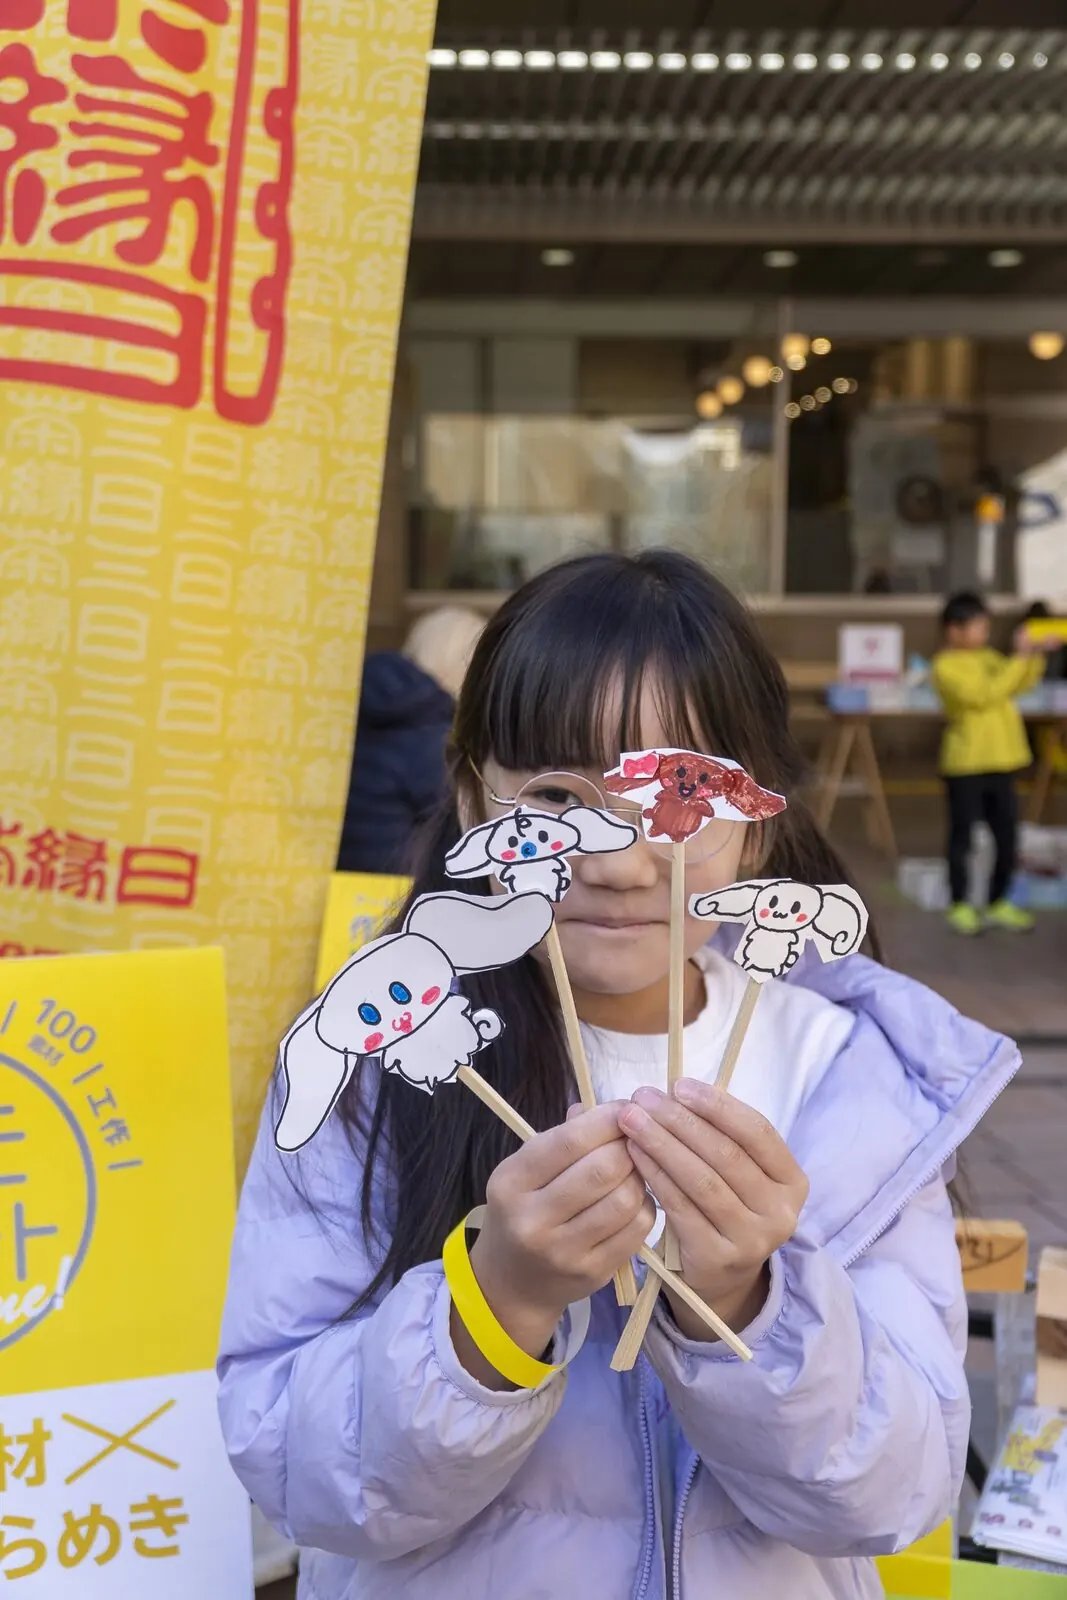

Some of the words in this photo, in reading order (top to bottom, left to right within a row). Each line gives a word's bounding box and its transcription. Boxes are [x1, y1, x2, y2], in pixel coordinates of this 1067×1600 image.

[0, 820, 199, 909] 縁日
[35, 998, 97, 1055] 100
[86, 1085, 132, 1147] 工作
